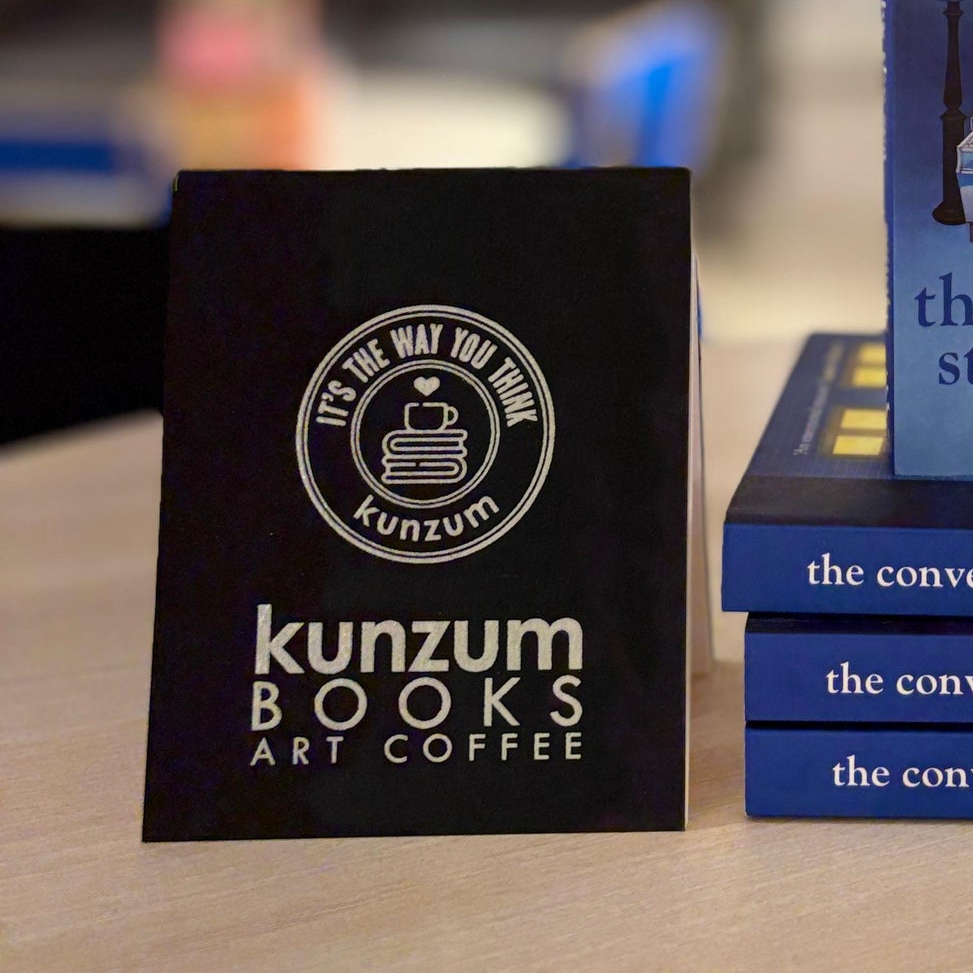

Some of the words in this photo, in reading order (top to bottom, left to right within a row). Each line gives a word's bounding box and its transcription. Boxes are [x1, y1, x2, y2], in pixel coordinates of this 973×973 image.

[342, 339, 391, 382] THE
[391, 324, 443, 358] WAY
[452, 327, 498, 369] YOU
[490, 358, 538, 427] THINK
[353, 494, 500, 541] kunzum
[807, 553, 864, 585] the
[254, 603, 584, 675] kunzum
[826, 662, 884, 694] the
[250, 674, 583, 731] BOOKS
[250, 736, 344, 766] ART
[384, 732, 583, 763] COFFEE
[832, 755, 890, 787] the
